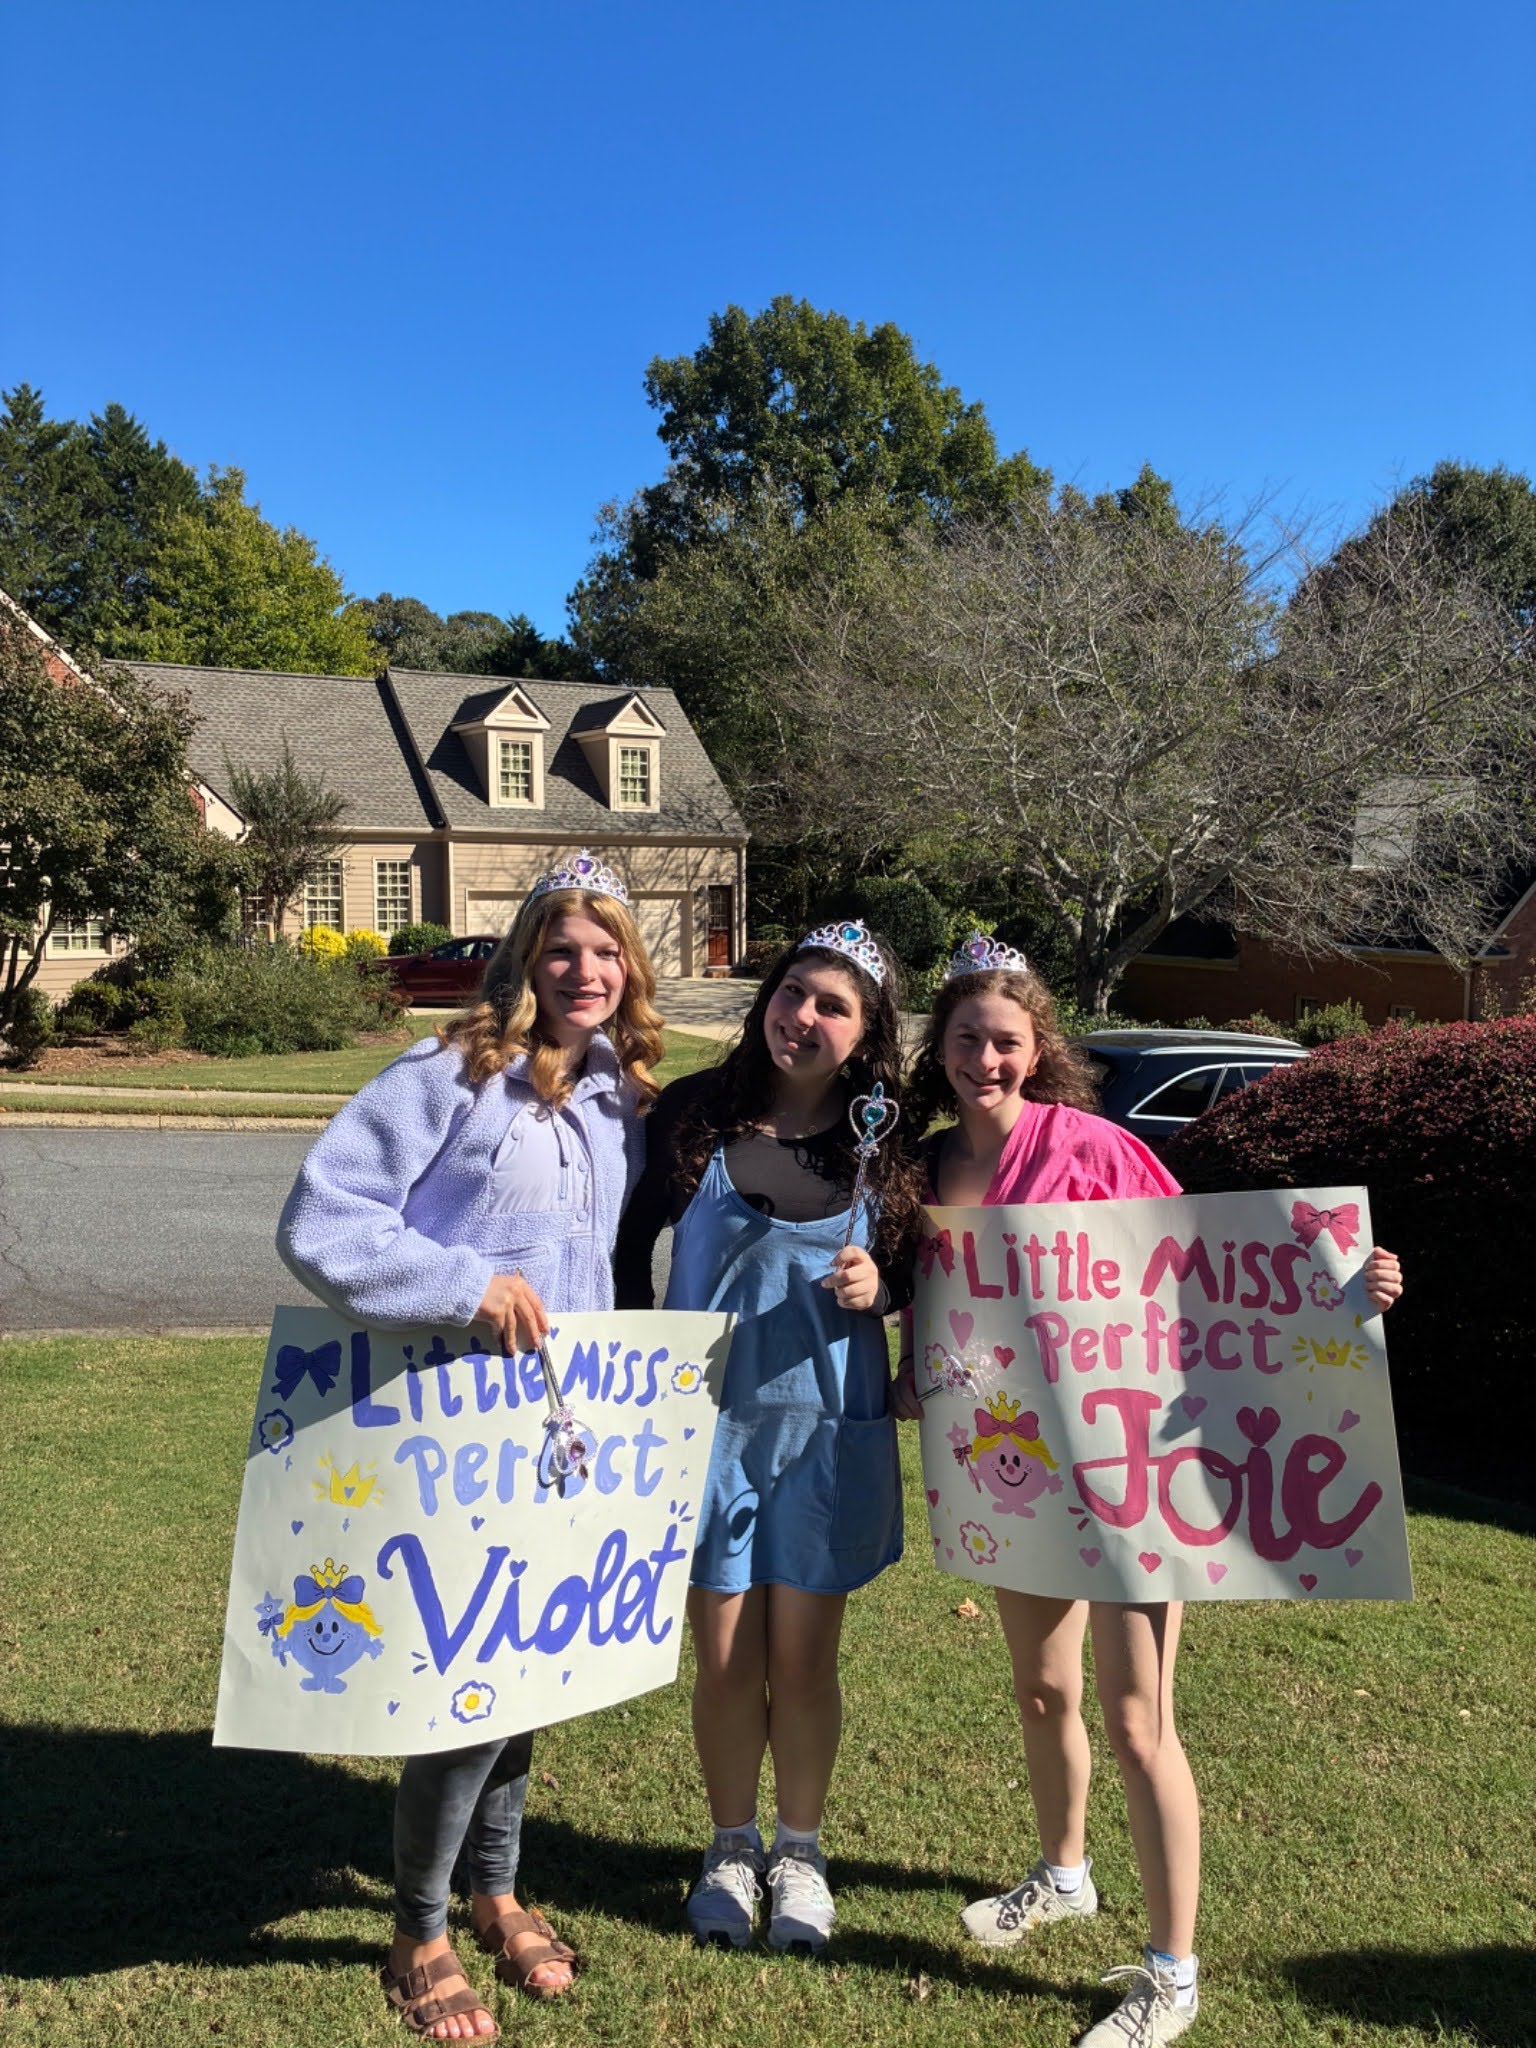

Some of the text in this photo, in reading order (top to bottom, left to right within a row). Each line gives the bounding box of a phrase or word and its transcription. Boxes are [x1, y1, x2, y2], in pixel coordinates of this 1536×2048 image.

[962, 1230, 1312, 1315] Little Miss
[350, 1331, 669, 1428] Little Miss
[1023, 1300, 1283, 1383] Perfect
[1072, 1387, 1384, 1562] Joie
[376, 1523, 687, 1676] Violet
